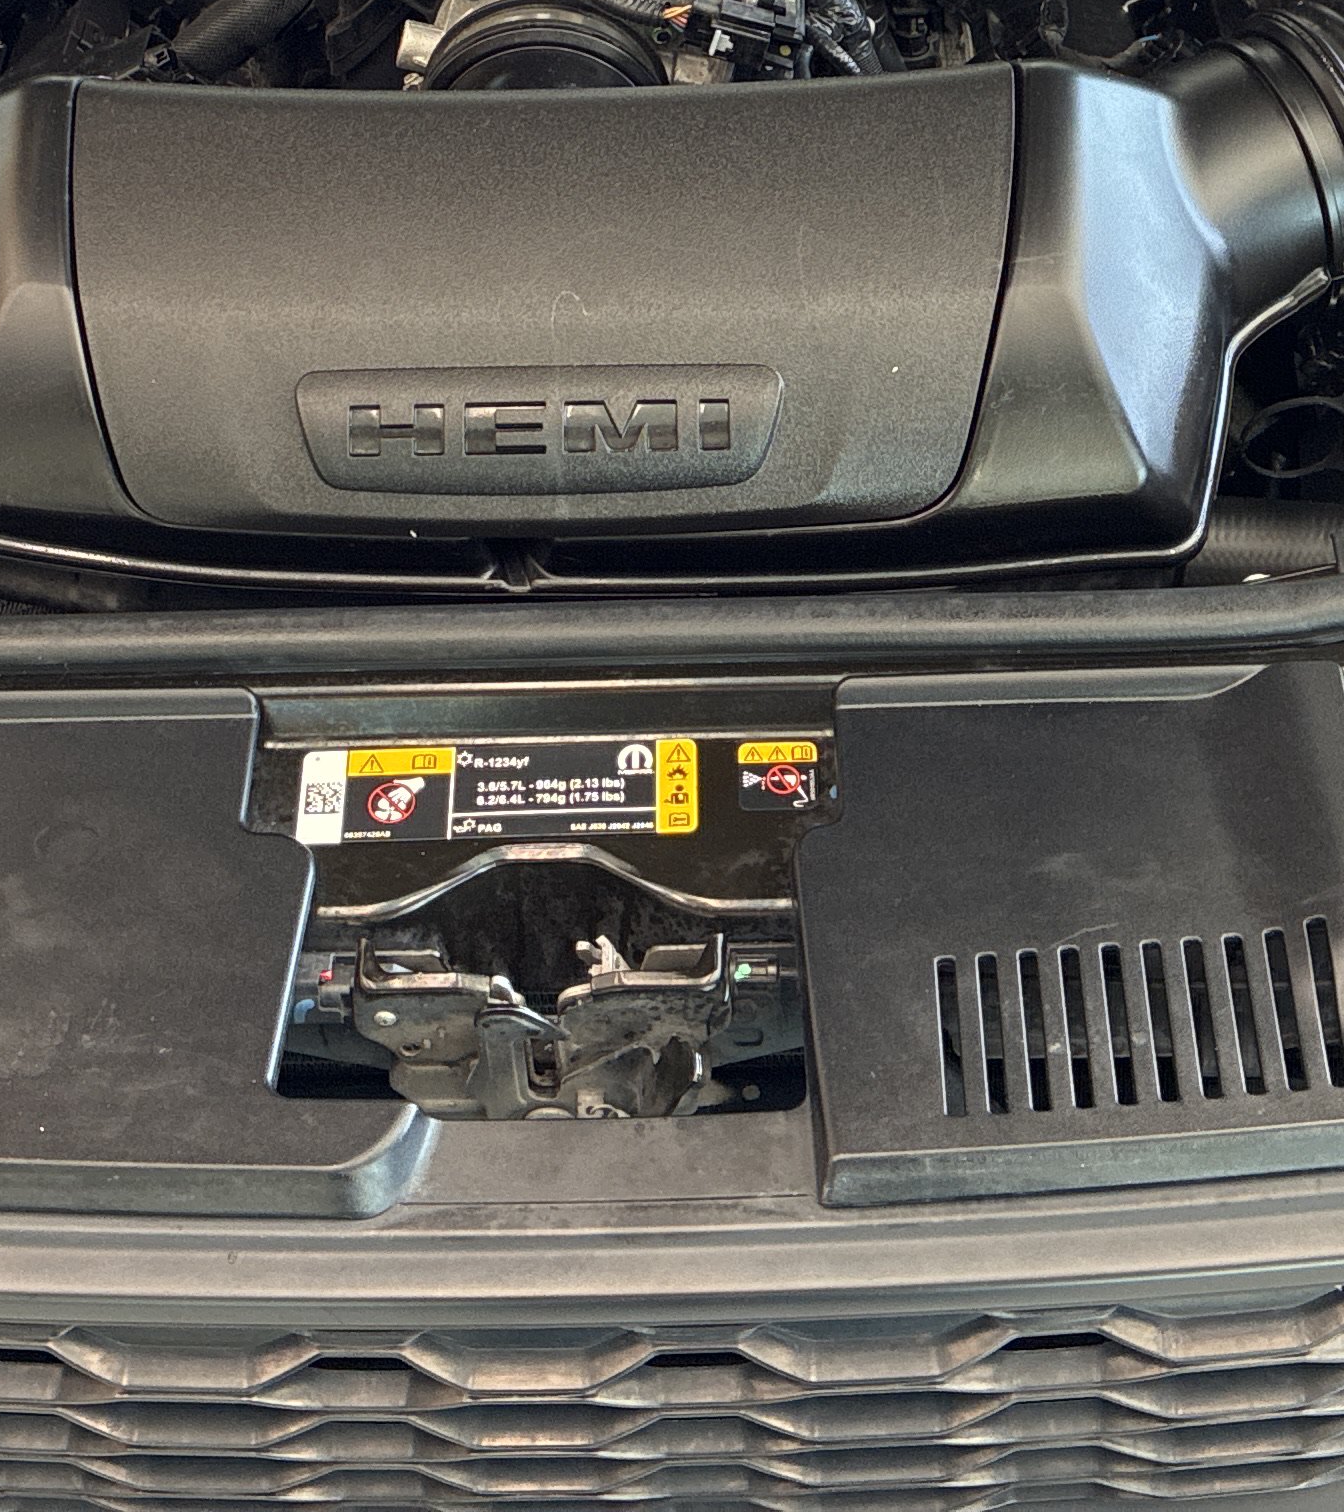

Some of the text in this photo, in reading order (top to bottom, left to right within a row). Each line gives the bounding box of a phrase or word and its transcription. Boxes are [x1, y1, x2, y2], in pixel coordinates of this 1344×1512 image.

[349, 398, 731, 456] HEMI
[474, 756, 530, 769] R-1234yf
[477, 780, 526, 793] 3.6/5.7L
[570, 778, 599, 791] (2.13
[602, 777, 625, 790] lbs)
[476, 794, 526, 806] 6.2/6.4L
[536, 792, 566, 806] 794g
[569, 791, 599, 805] (1.75
[602, 791, 625, 804] lbs)
[477, 823, 502, 834] PAG
